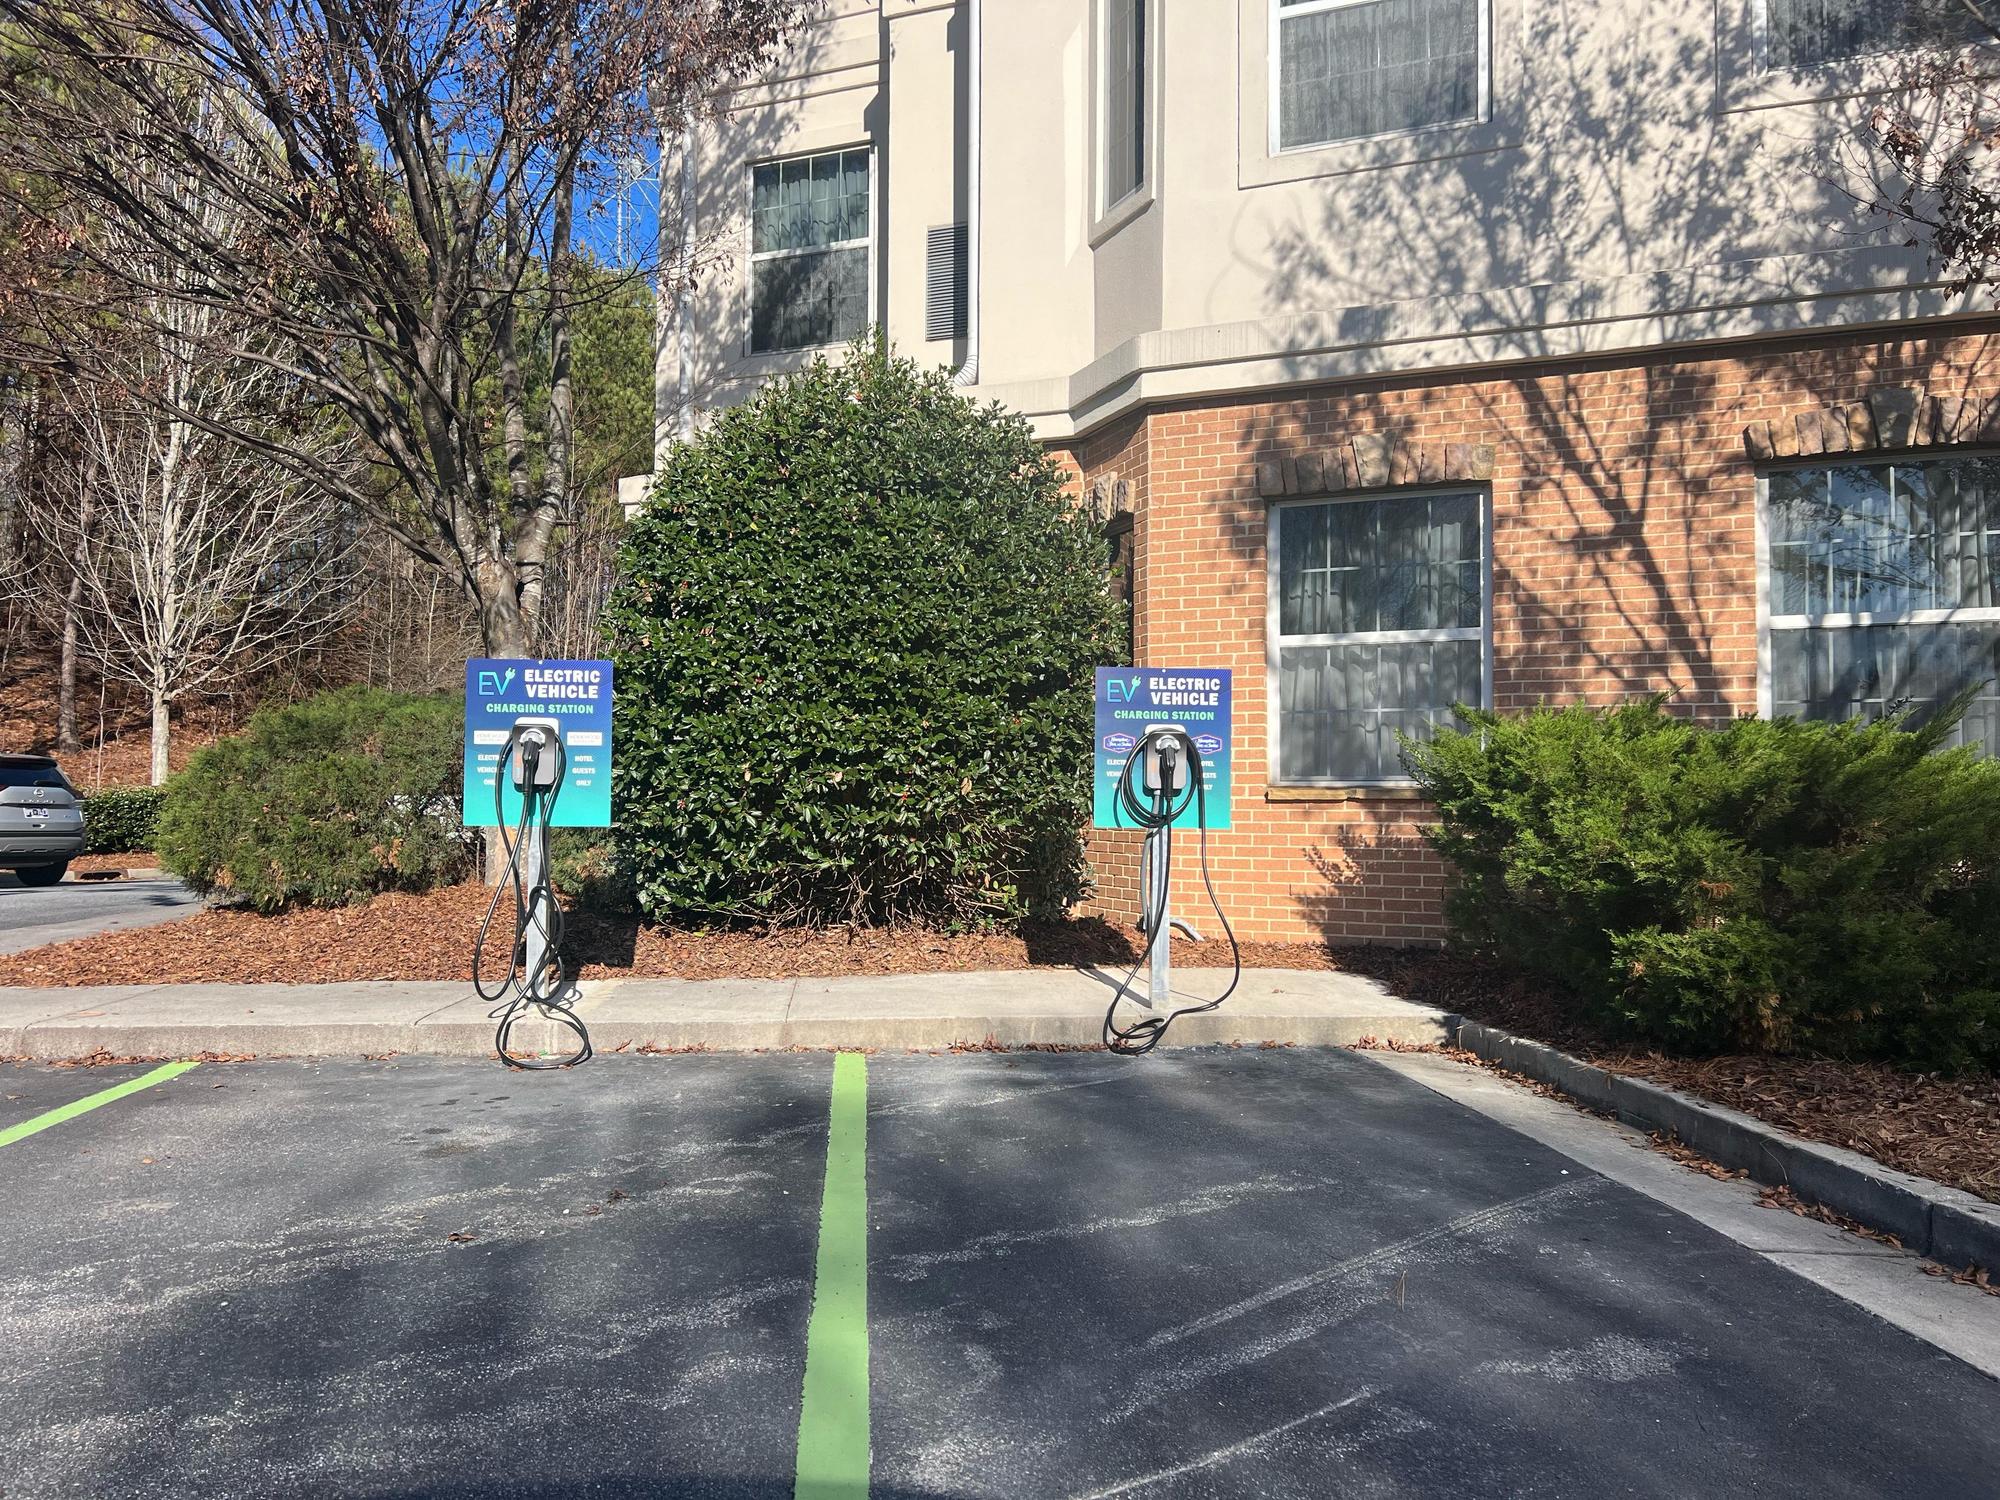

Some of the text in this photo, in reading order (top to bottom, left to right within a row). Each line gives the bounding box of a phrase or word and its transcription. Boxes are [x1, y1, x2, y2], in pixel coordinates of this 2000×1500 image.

[479, 671, 512, 696] EV
[524, 669, 601, 684] ELECTRIC
[1150, 677, 1220, 690] ELECTRIC
[525, 684, 599, 699] VEHICLE
[1107, 679, 1137, 703] EV
[1150, 692, 1219, 706] VEHICLE
[486, 703, 594, 714] CHARGING STATION
[1114, 710, 1214, 721] CHARGING STATION
